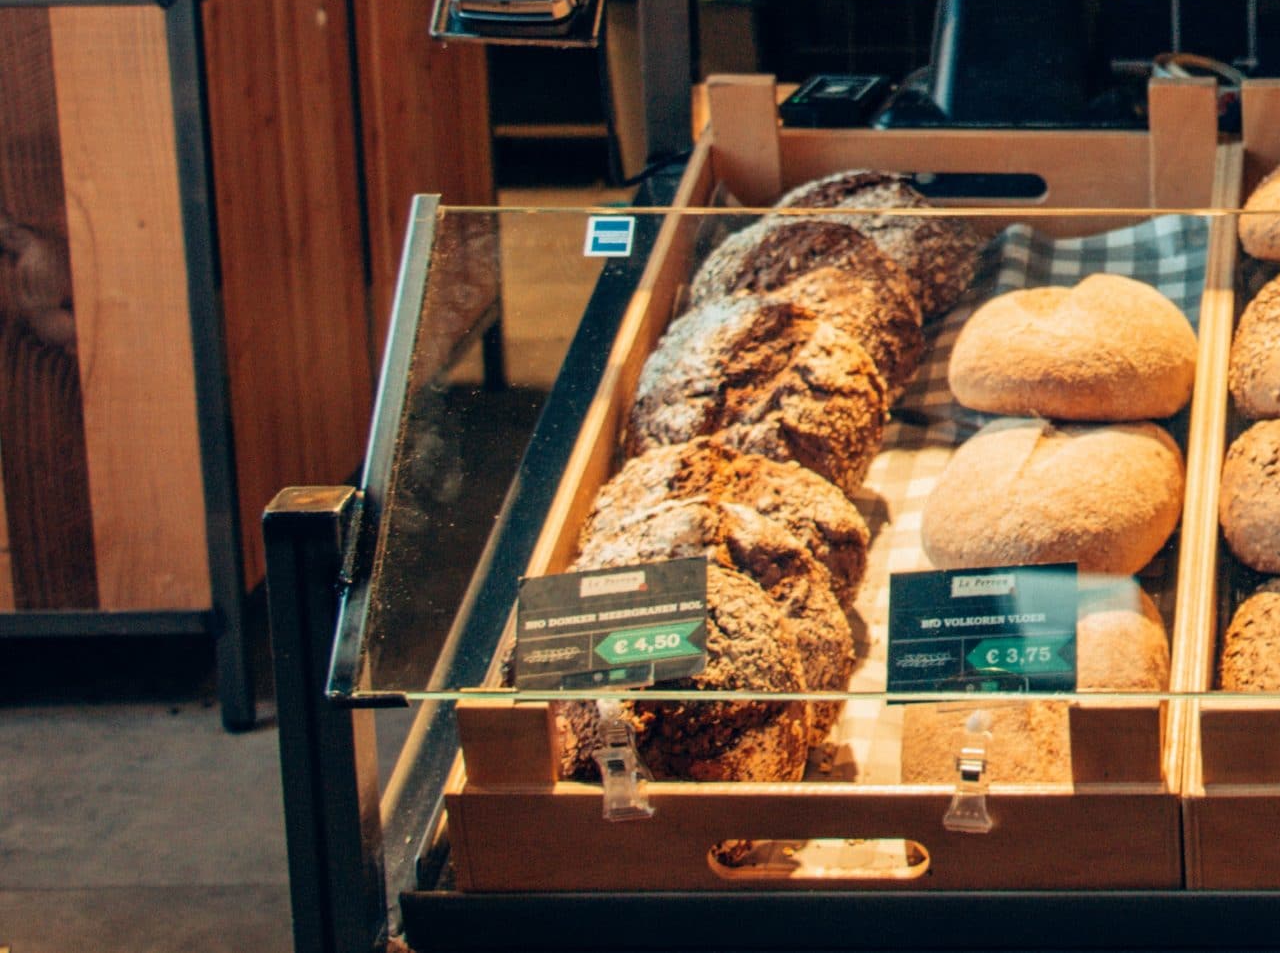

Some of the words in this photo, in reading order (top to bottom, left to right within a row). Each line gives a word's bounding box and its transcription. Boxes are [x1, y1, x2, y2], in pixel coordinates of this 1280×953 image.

[974, 577, 1009, 588] Perron
[525, 619, 546, 630] BIO
[548, 613, 597, 628] DONKER
[678, 599, 703, 612] BOL
[921, 618, 942, 629] BIO
[944, 615, 1006, 627] VOLKOREN
[1007, 613, 1047, 624] VLOER
[613, 639, 629, 655] €
[634, 633, 681, 655] 4,50
[985, 649, 1000, 665] €
[1005, 646, 1051, 665] 3,75
